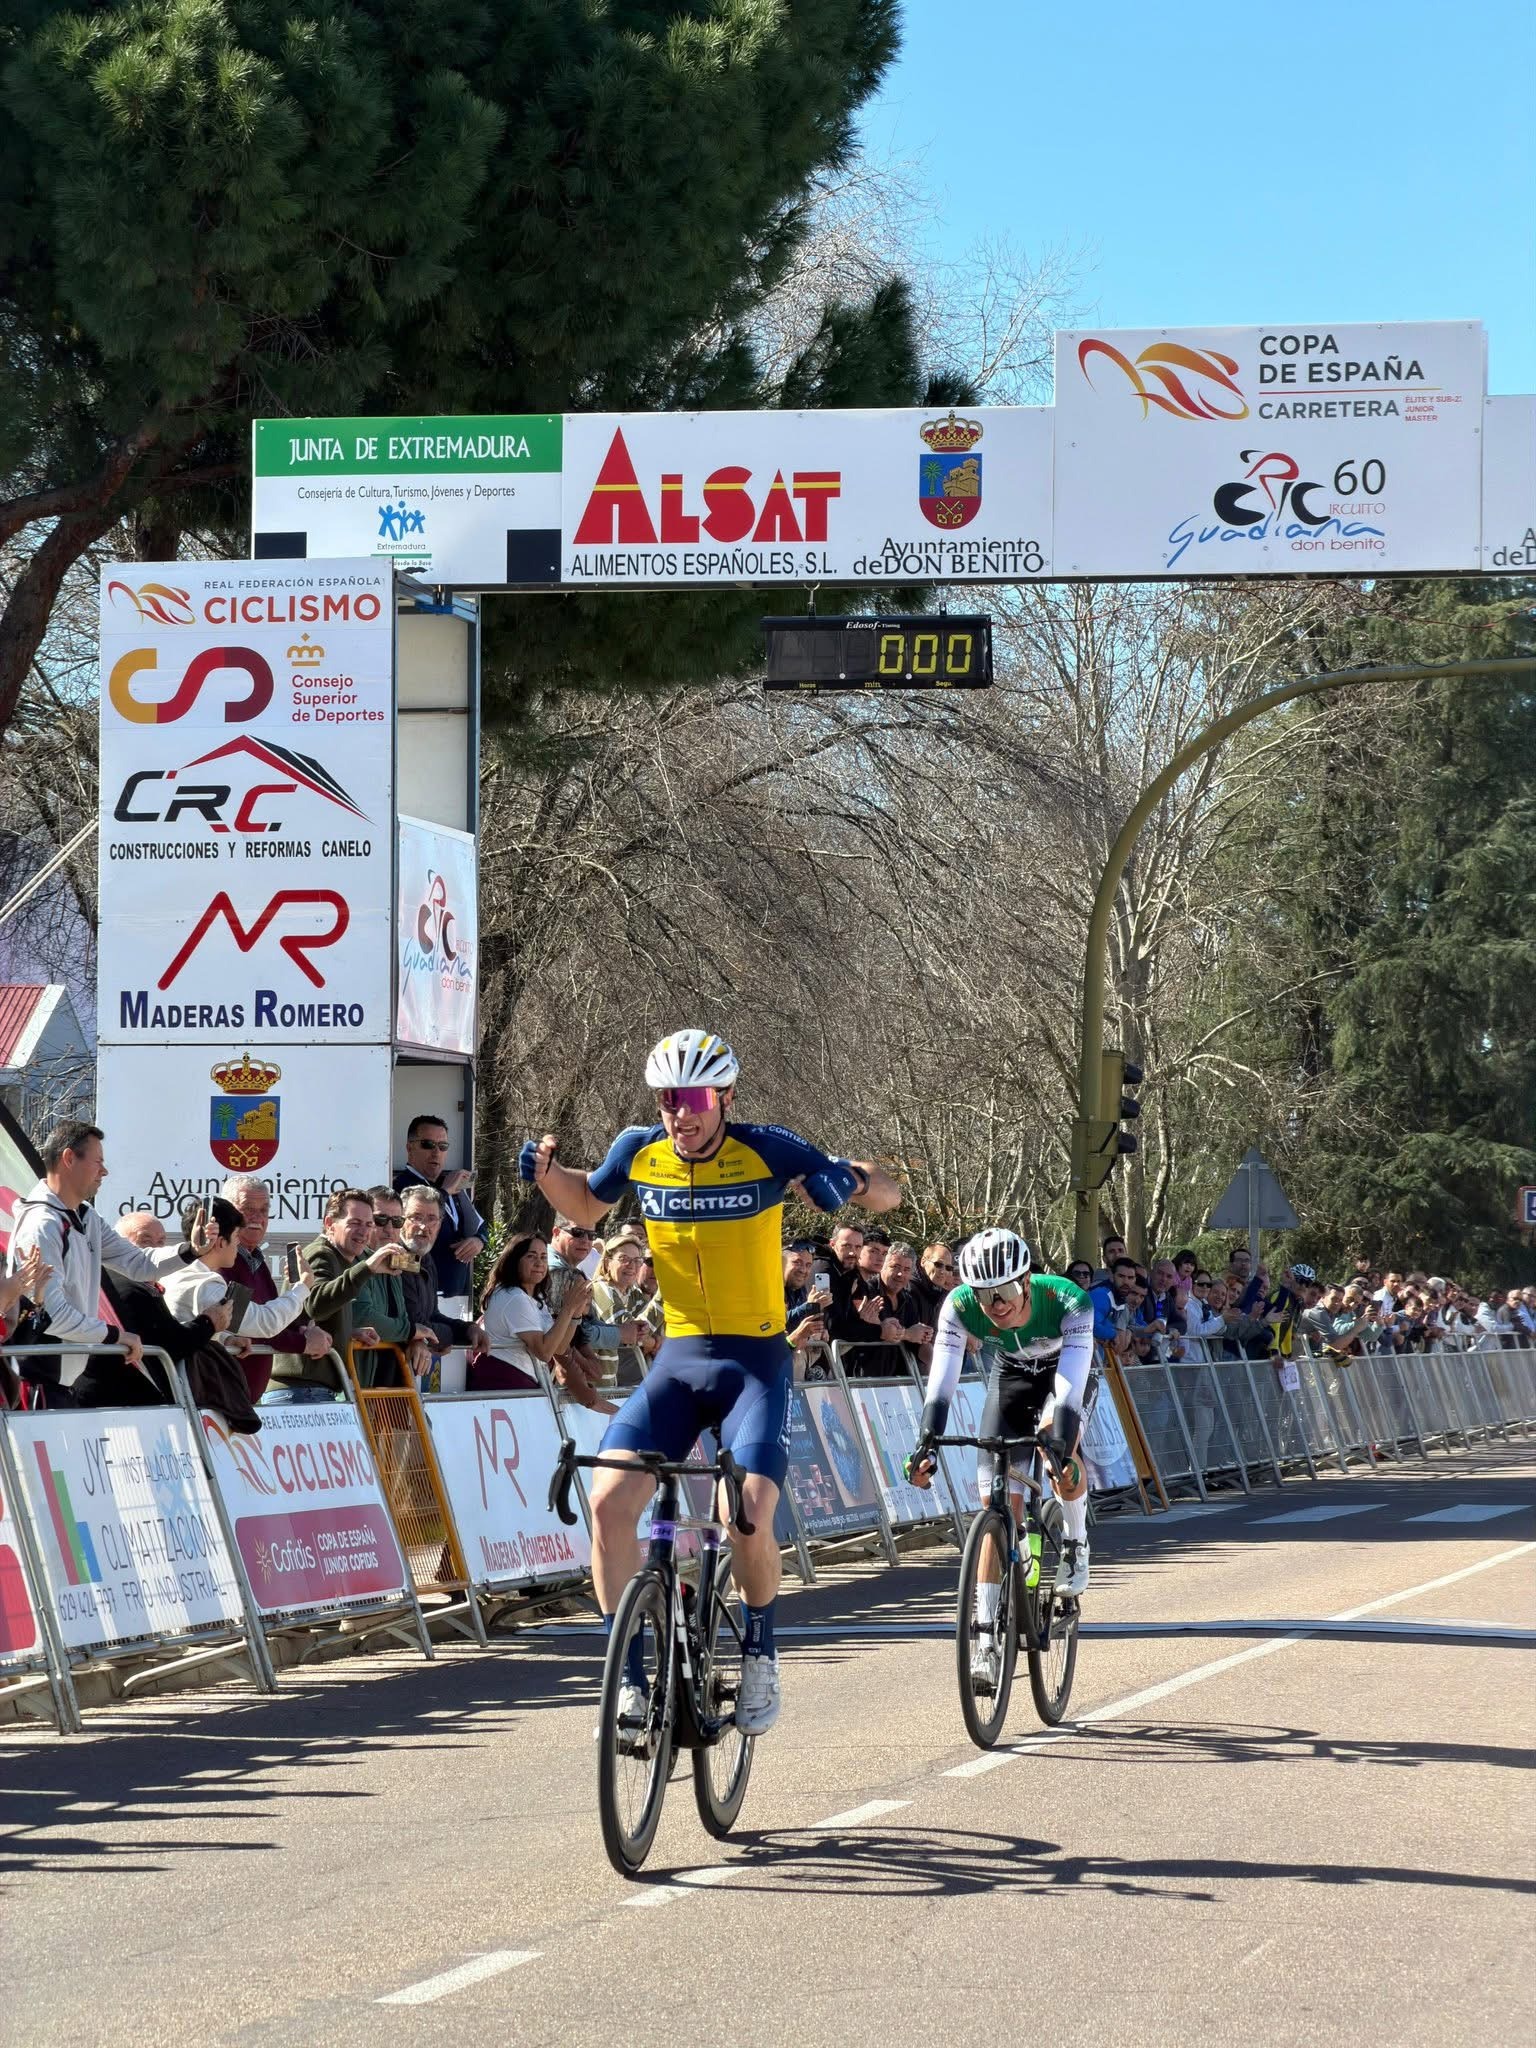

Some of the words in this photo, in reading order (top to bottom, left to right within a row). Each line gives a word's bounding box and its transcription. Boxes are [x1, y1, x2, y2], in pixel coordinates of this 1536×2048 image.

[1259, 334, 1340, 356] COPA
[1259, 363, 1297, 384] DE
[1308, 355, 1425, 383] ESPAÑA
[1258, 400, 1400, 420] CARRETERA
[289, 437, 344, 465] JUNTA
[356, 437, 378, 460] DE
[388, 435, 531, 460] EXTREMADURA
[572, 425, 841, 544] ALSAT
[1333, 458, 1386, 497] 60
[297, 486, 343, 502] Consejería
[346, 486, 356, 499] de
[466, 488, 471, 501] y
[474, 485, 516, 501] Deportes
[377, 543, 426, 551] Extremadura
[880, 537, 1040, 561] Ayuntamiento
[1291, 538, 1326, 551] don
[1330, 536, 1385, 551] benito
[571, 554, 678, 577] ALIMENTOS
[683, 548, 799, 579] ESPAÑOLES,
[806, 551, 838, 574] S.L.
[951, 552, 1045, 575] BENITO
[204, 580, 235, 590] REAL
[238, 576, 314, 590] FEDERACIÓN
[318, 575, 382, 588] ESPAÑOLA
[204, 593, 381, 625] CICLISMO
[291, 675, 354, 691] Consejo
[292, 692, 359, 707] Superior
[291, 708, 311, 722] de
[315, 708, 385, 725] Deportes
[109, 841, 220, 861] CONSTRUCCIONES
[228, 842, 237, 859] Y
[245, 840, 312, 859] REFORMAS
[321, 839, 372, 857] CANELO
[119, 990, 245, 1029] MADERAS
[254, 989, 365, 1028] ROMERO
[768, 1125, 808, 1146] CORTIZO
[668, 1192, 753, 1211] CORTIZO
[262, 1415, 282, 1430] REAL
[283, 1411, 325, 1429] FEDERACIÓN
[82, 1437, 114, 1496] JYF
[272, 1439, 375, 1494] CICLISMO
[317, 1532, 339, 1551] COPA
[337, 1531, 350, 1549] DE
[270, 1533, 316, 1573] Cofidis
[323, 1555, 350, 1576] JUNIOR
[349, 1551, 379, 1571] COFIDIS
